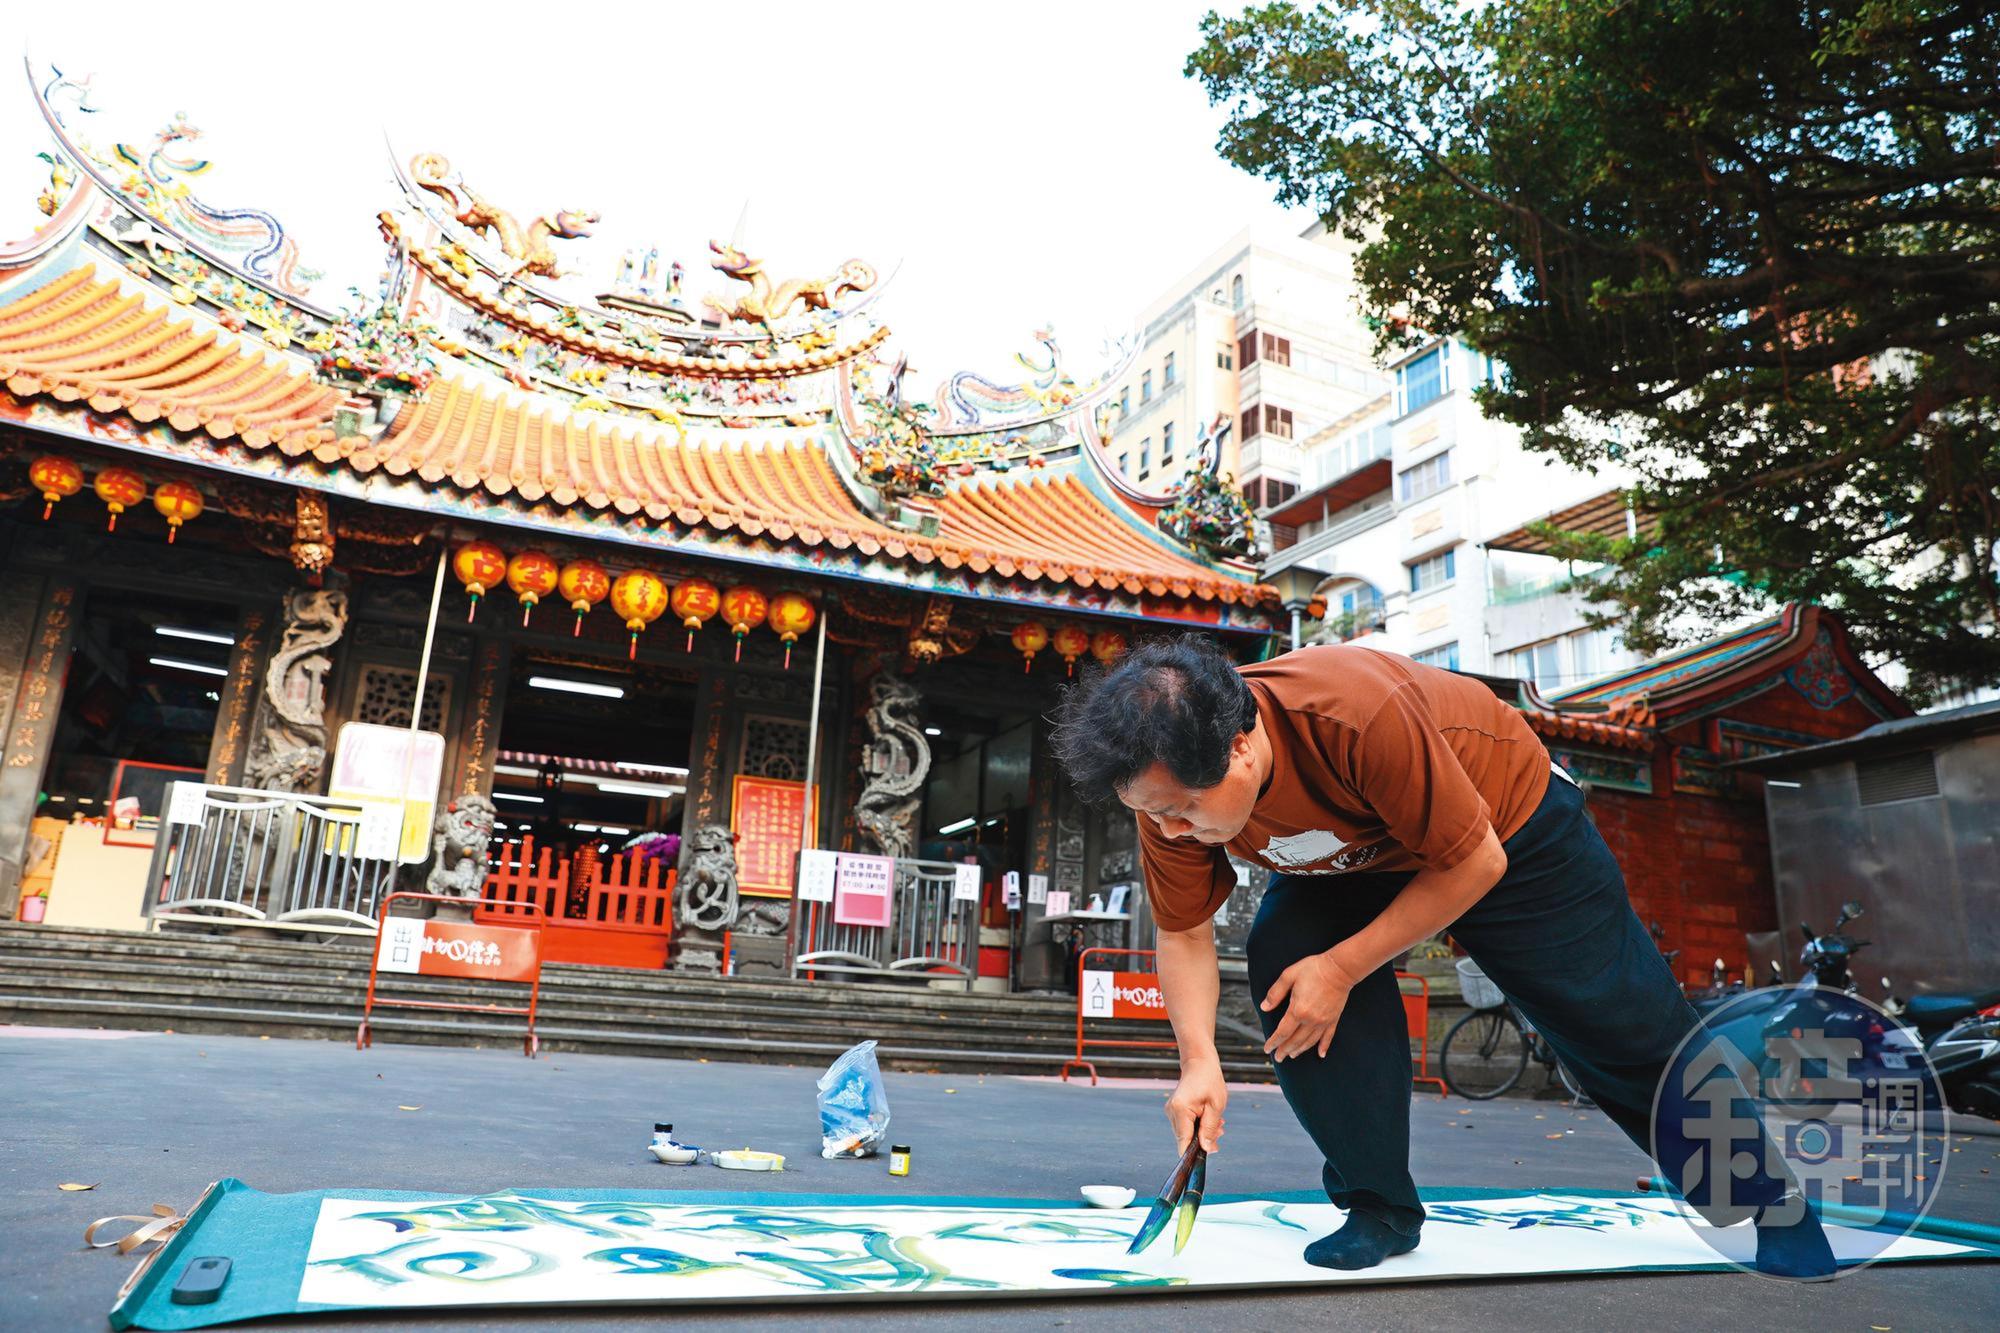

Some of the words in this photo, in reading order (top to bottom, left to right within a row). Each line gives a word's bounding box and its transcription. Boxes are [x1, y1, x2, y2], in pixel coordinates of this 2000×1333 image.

[961, 871, 973, 894] 入口
[393, 926, 412, 963] 出口
[1091, 977, 1105, 1010] 入口
